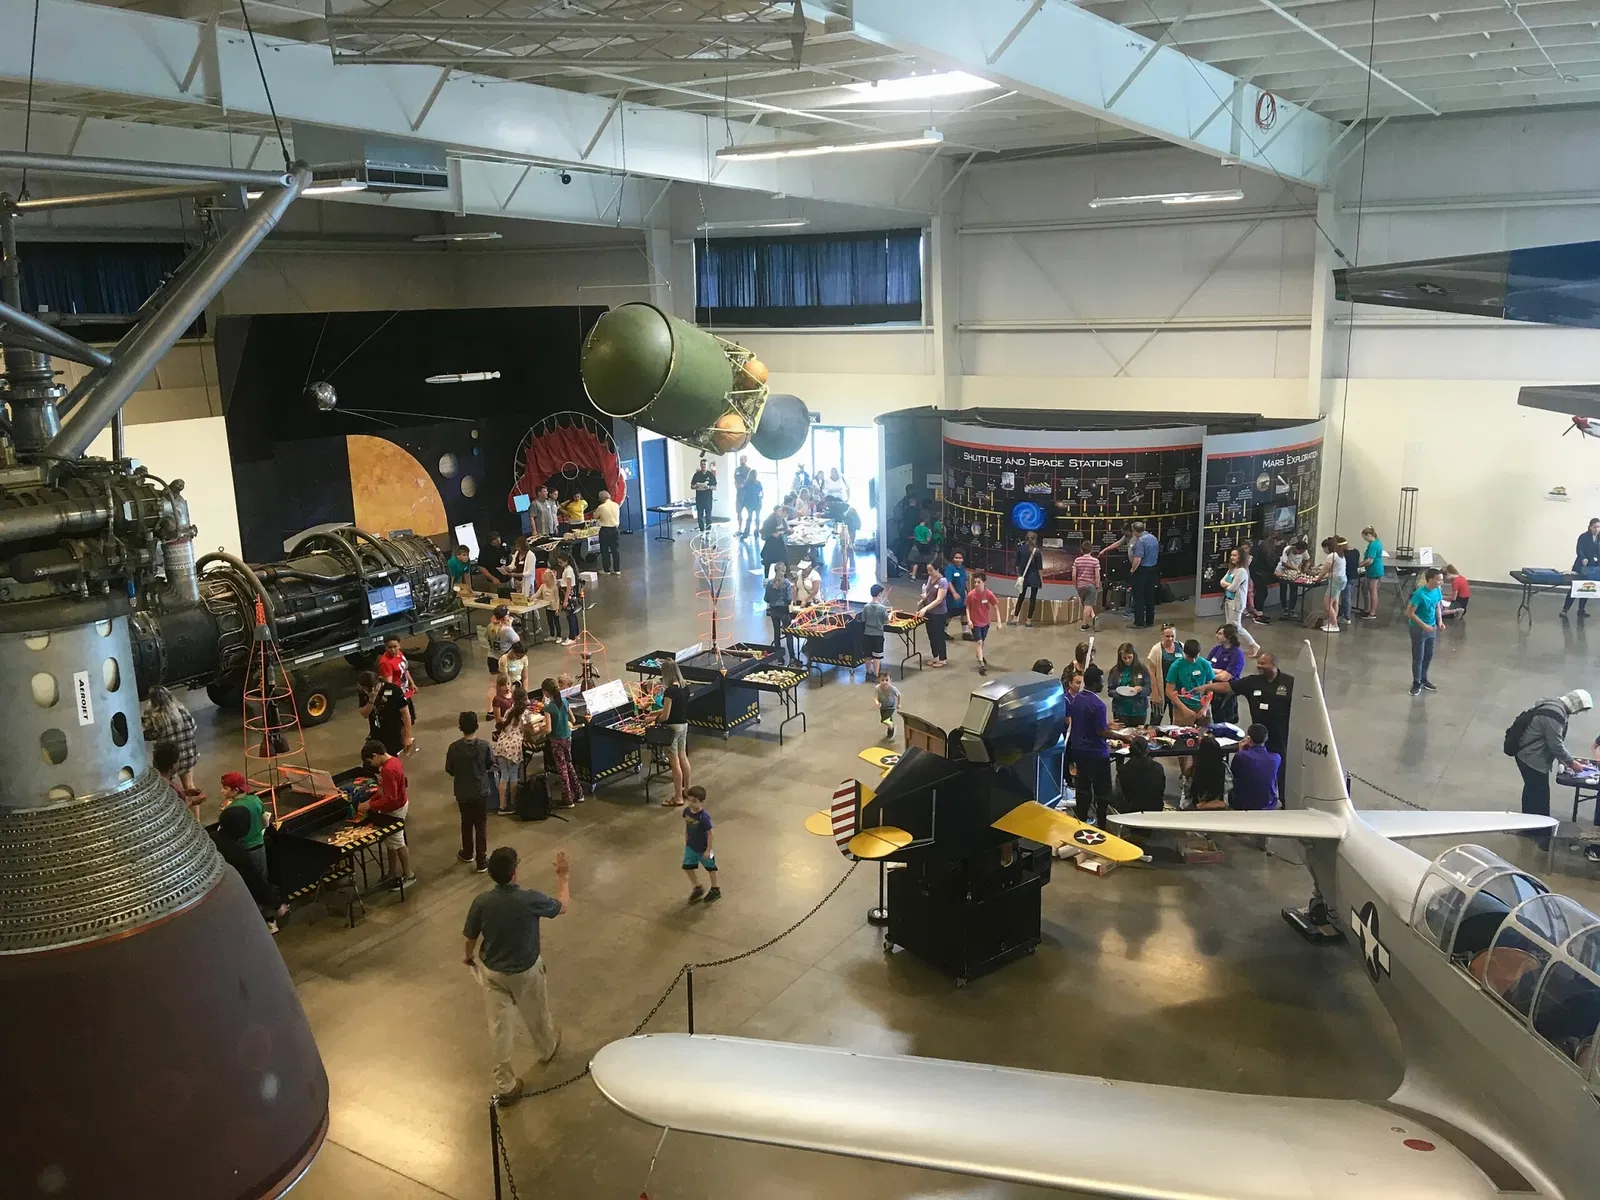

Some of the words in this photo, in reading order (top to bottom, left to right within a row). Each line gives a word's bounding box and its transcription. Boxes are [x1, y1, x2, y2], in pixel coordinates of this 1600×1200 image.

[963, 451, 1002, 465] SHUTTLES
[1004, 457, 1026, 466] AND
[1029, 457, 1065, 468] SPACE
[1068, 458, 1124, 468] STATIONS
[1262, 458, 1285, 468] MARS
[1286, 450, 1318, 465] EXPLORATIO
[78, 679, 89, 720] AEROJET
